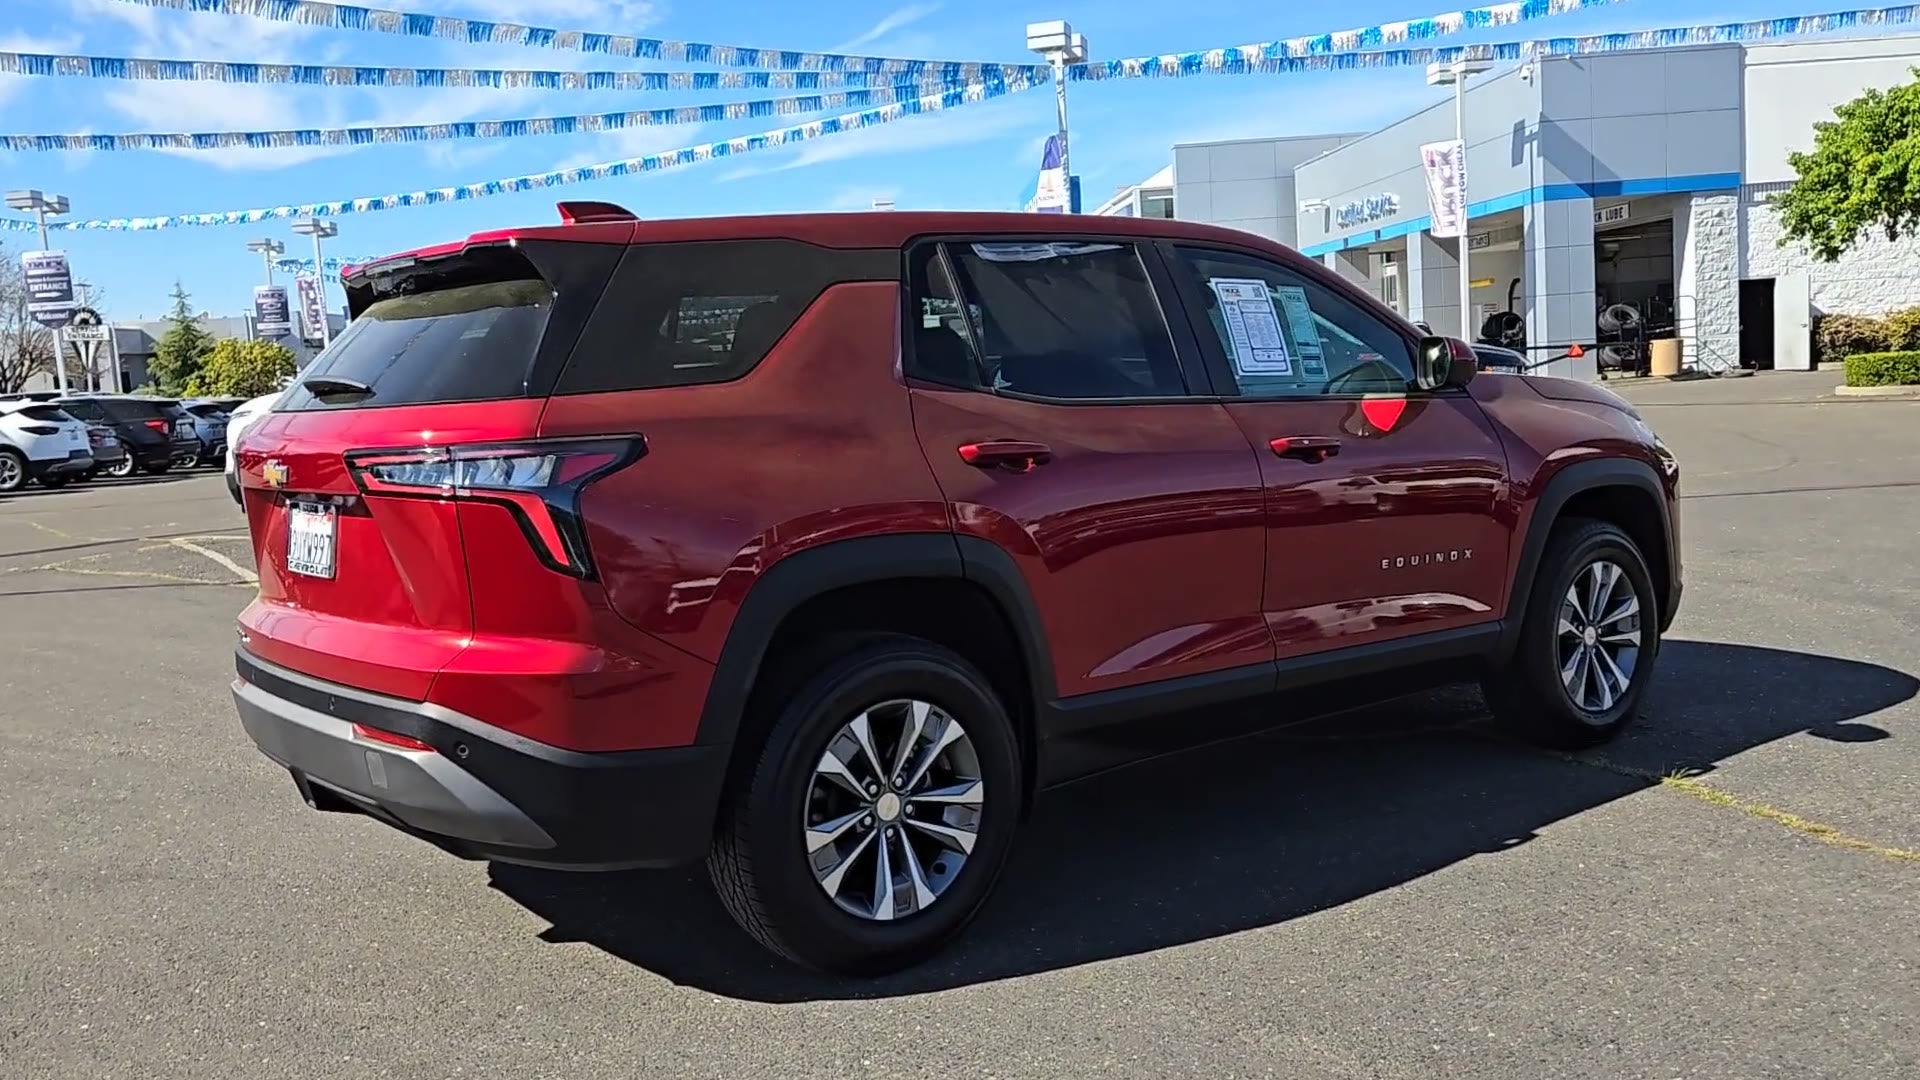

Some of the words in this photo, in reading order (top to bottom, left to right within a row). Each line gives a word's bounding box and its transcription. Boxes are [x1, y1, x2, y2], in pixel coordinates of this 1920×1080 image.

[1605, 206, 1624, 221] LUBE
[29, 281, 68, 292] ENTRANCE
[1381, 549, 1472, 569] EQUINOX
